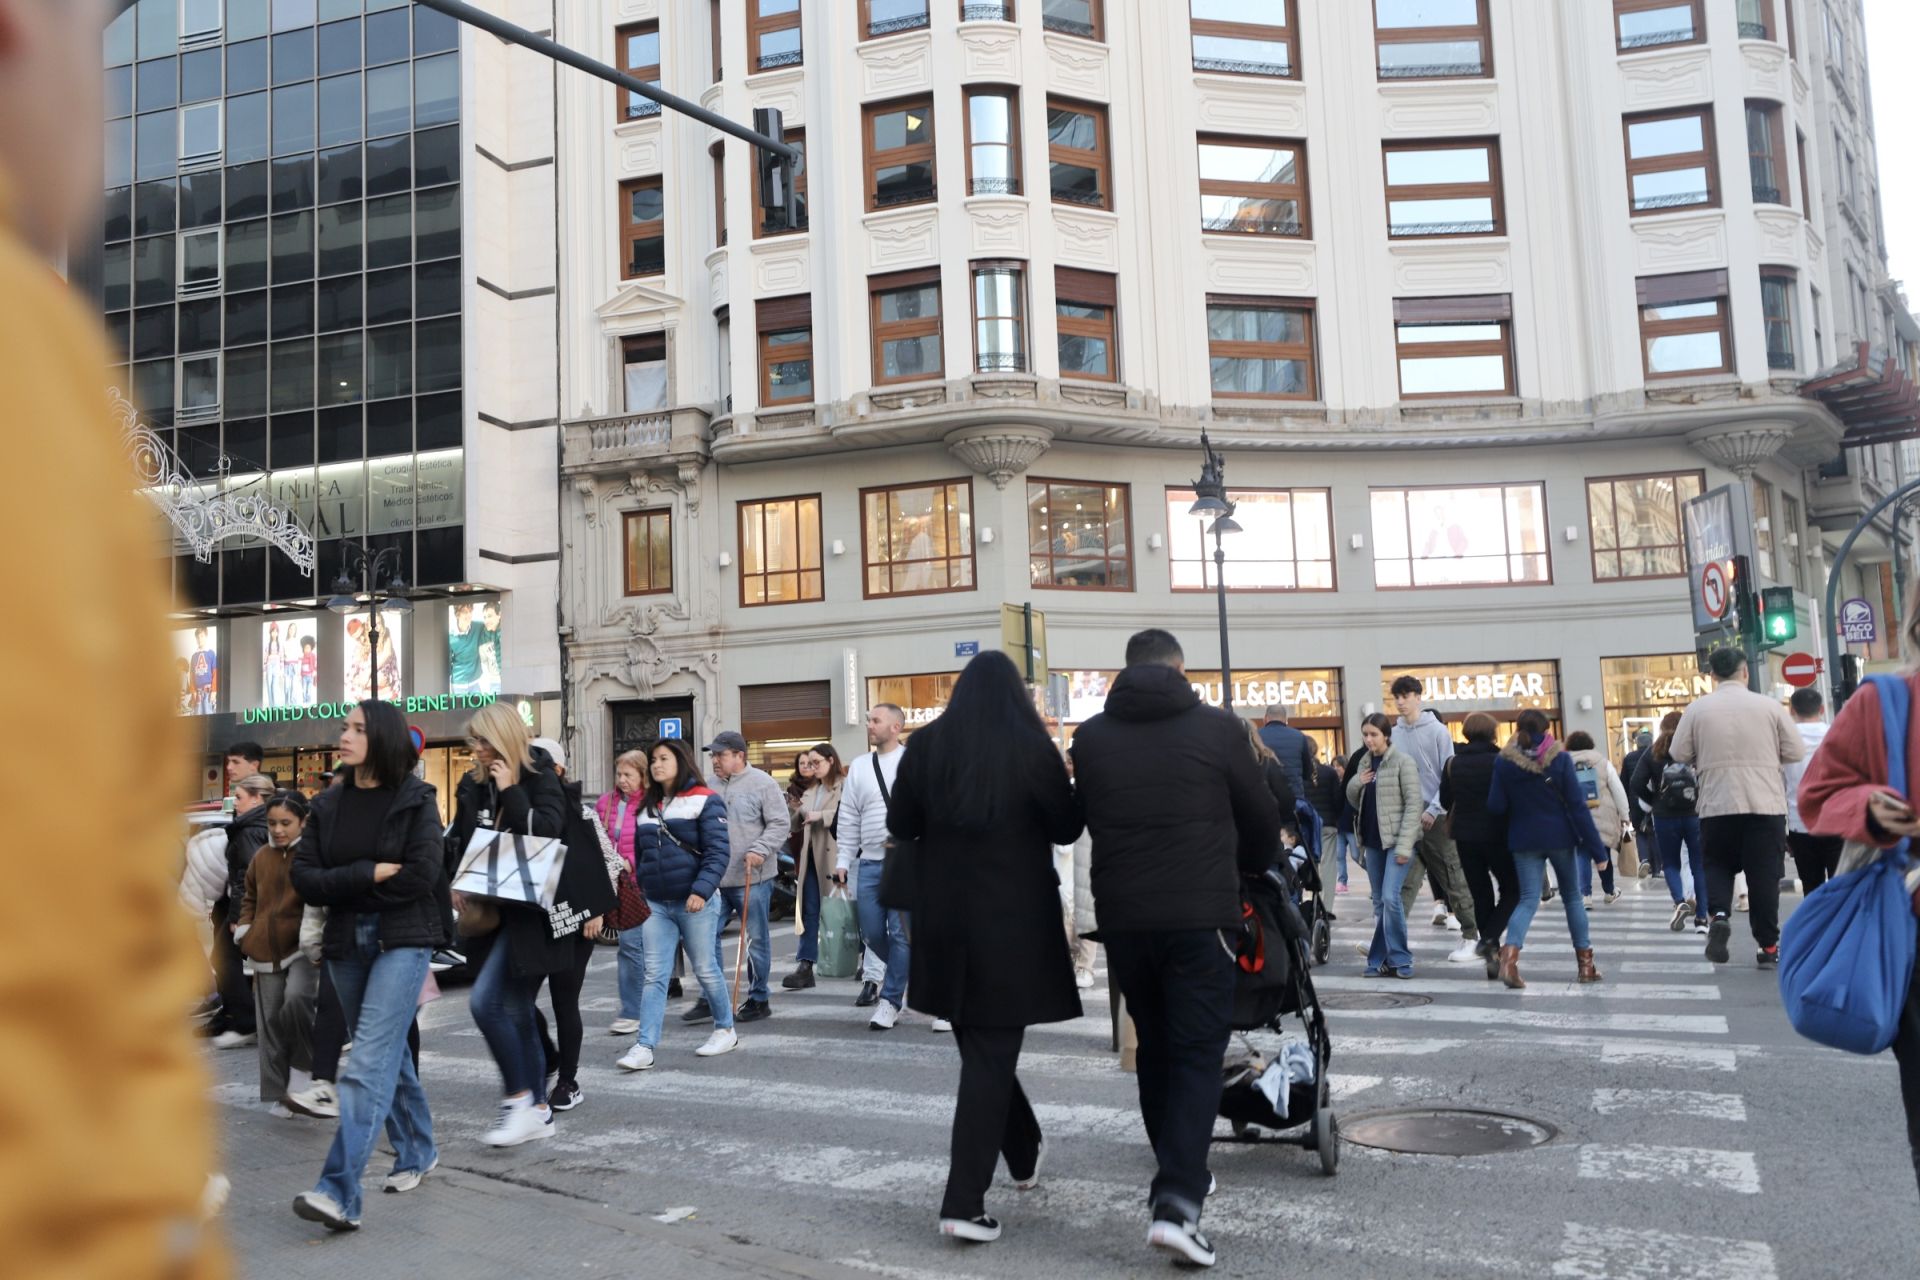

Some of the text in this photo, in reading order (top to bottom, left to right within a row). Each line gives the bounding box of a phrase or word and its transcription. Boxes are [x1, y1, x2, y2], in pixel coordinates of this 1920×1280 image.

[1843, 623, 1873, 633] TACO
[1846, 631, 1874, 641] BELL
[711, 653, 718, 664] 2
[1415, 672, 1545, 701] ULL&BEAR
[1643, 674, 1713, 699] MAN
[244, 704, 304, 724] UNITED
[308, 701, 360, 720] COLO
[407, 692, 498, 713] BENETTON
[664, 722, 676, 738] P
[551, 920, 566, 931] YOU
[564, 912, 583, 926] WANT
[553, 922, 580, 939] ATTRACT
